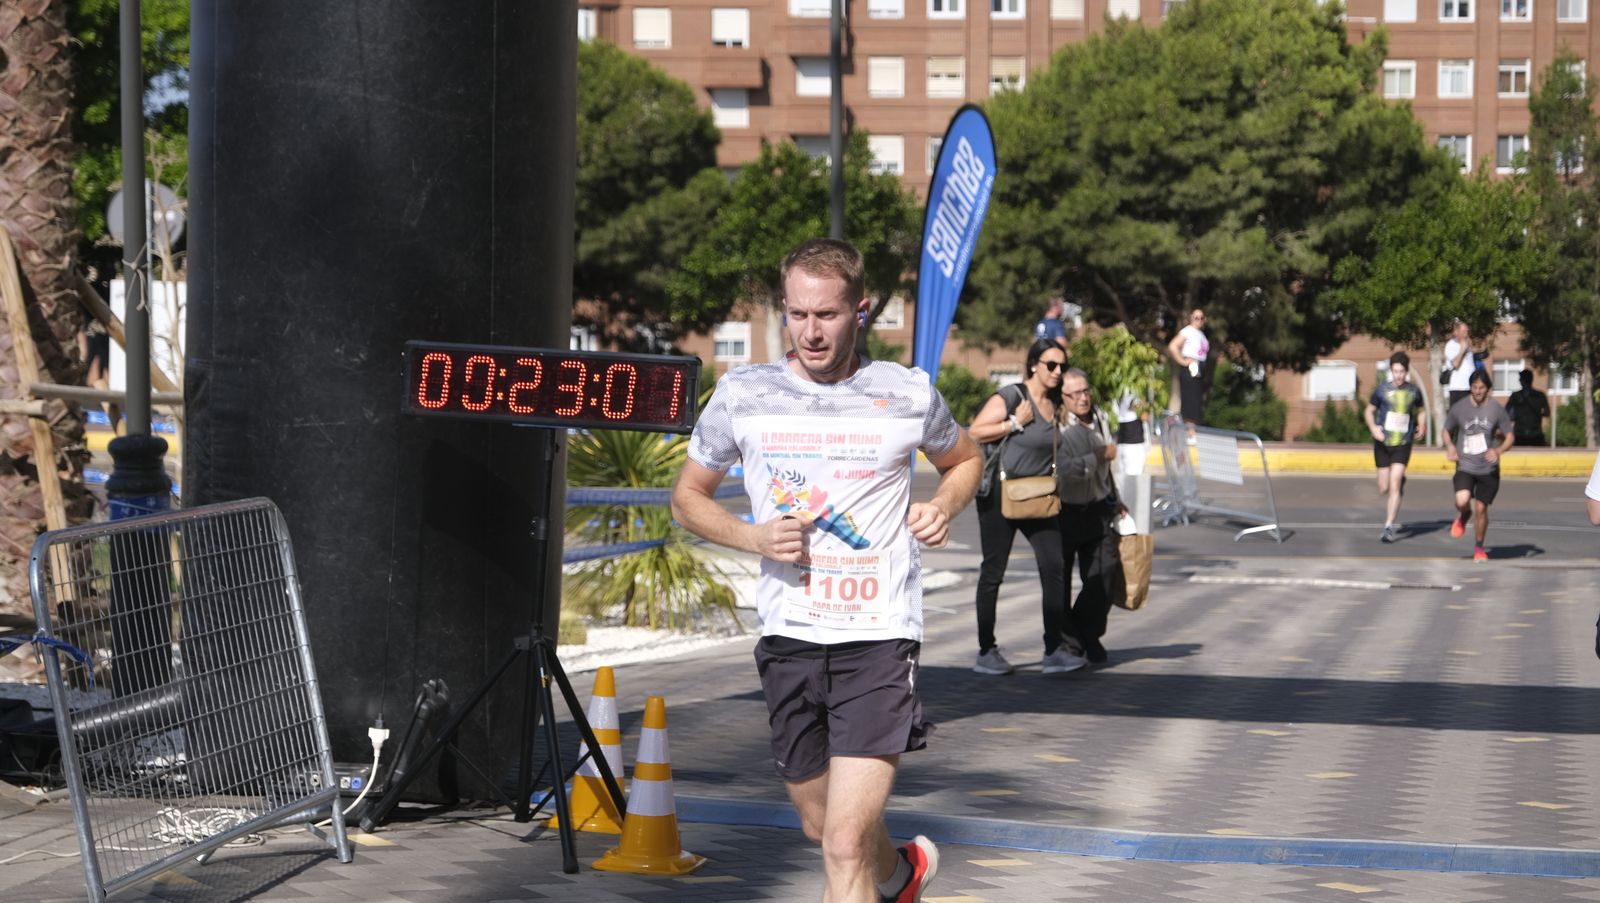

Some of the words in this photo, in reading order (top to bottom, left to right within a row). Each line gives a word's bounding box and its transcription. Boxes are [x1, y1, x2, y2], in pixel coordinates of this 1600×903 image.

[771, 431, 822, 445] CARRERA
[825, 433, 846, 445] SIN
[848, 434, 882, 446] HUMO
[799, 572, 879, 602] 1100
